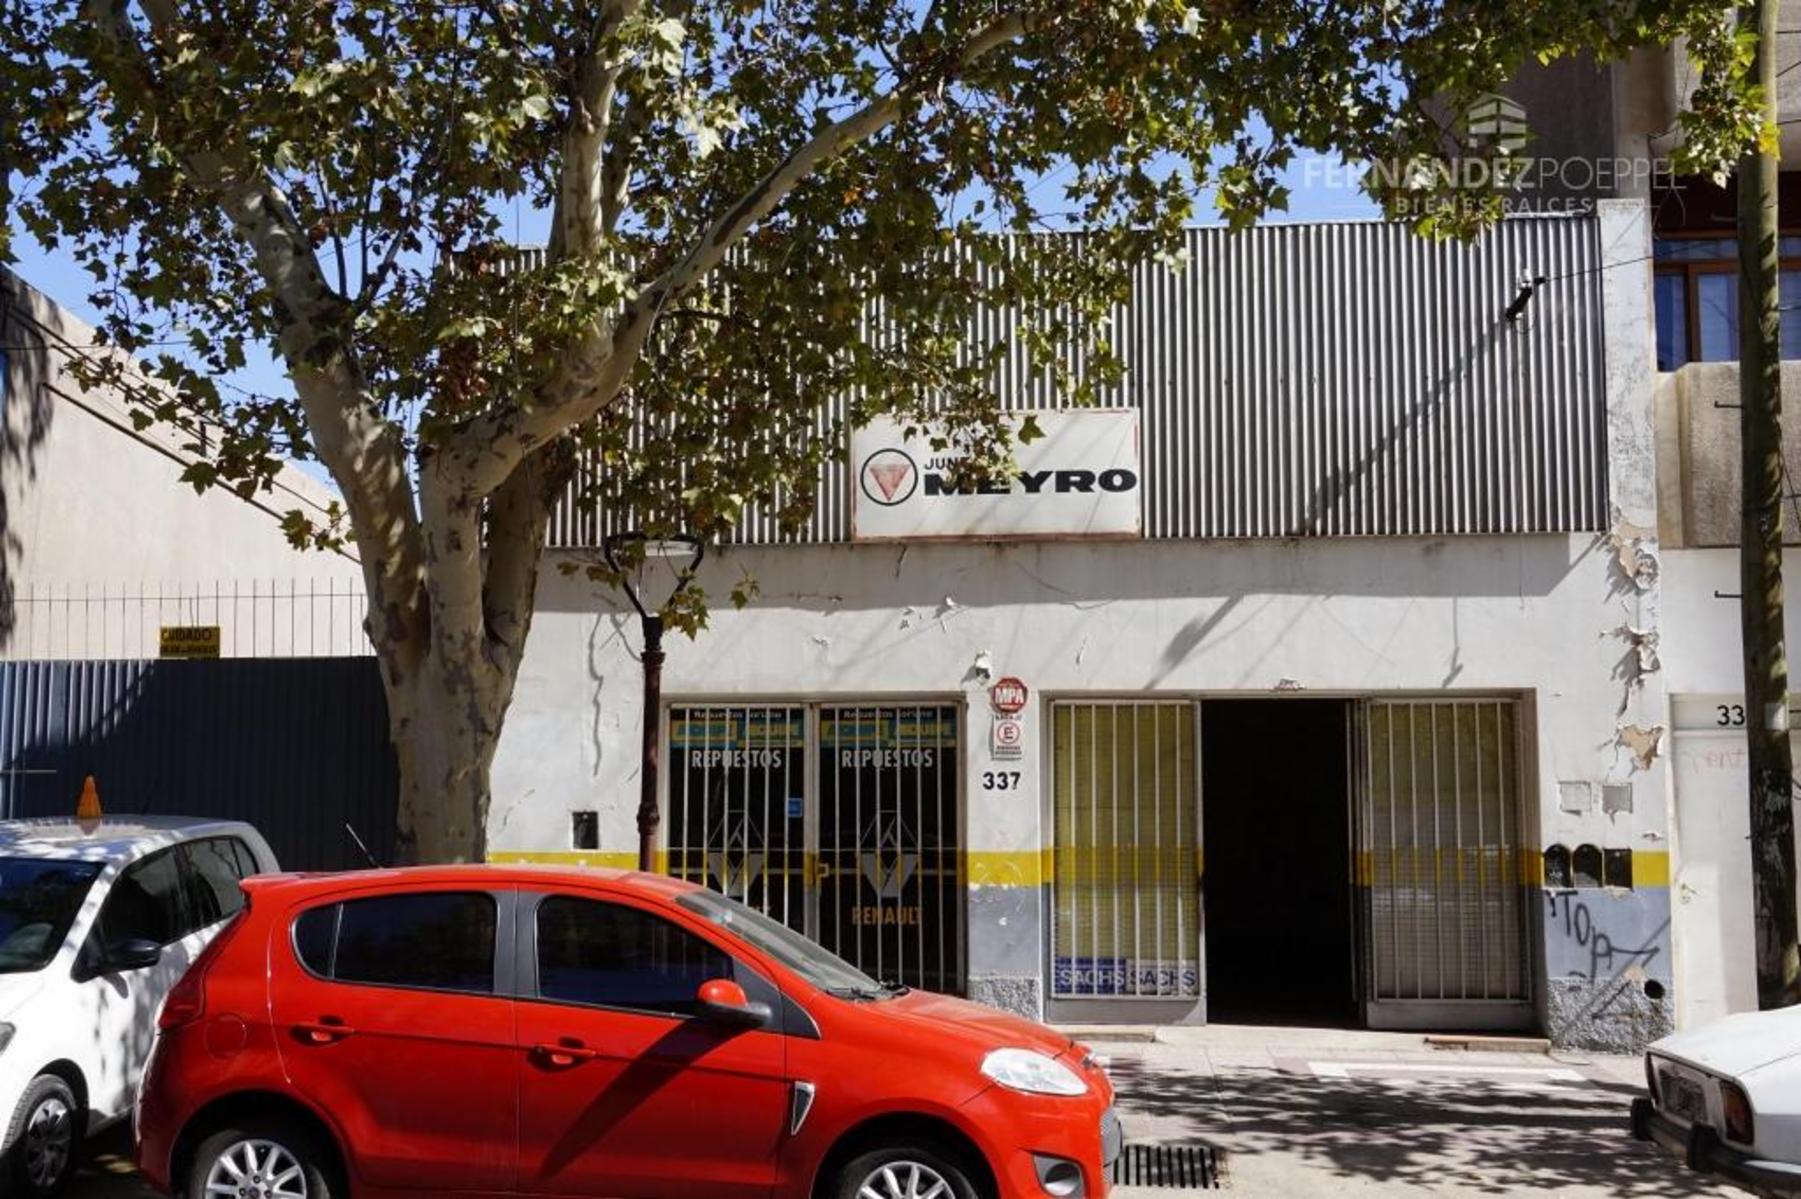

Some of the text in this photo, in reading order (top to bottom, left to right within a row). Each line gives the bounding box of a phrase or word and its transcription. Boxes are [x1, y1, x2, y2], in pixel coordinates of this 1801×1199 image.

[161, 628, 212, 641] CUIDADO
[1716, 705, 1746, 726] 33
[691, 750, 782, 768] REPUESTOS
[842, 750, 933, 768] REPUESTOS
[983, 771, 1021, 791] 337
[852, 906, 922, 925] RENAULT
[1060, 969, 1196, 987] SACHS SACHS
